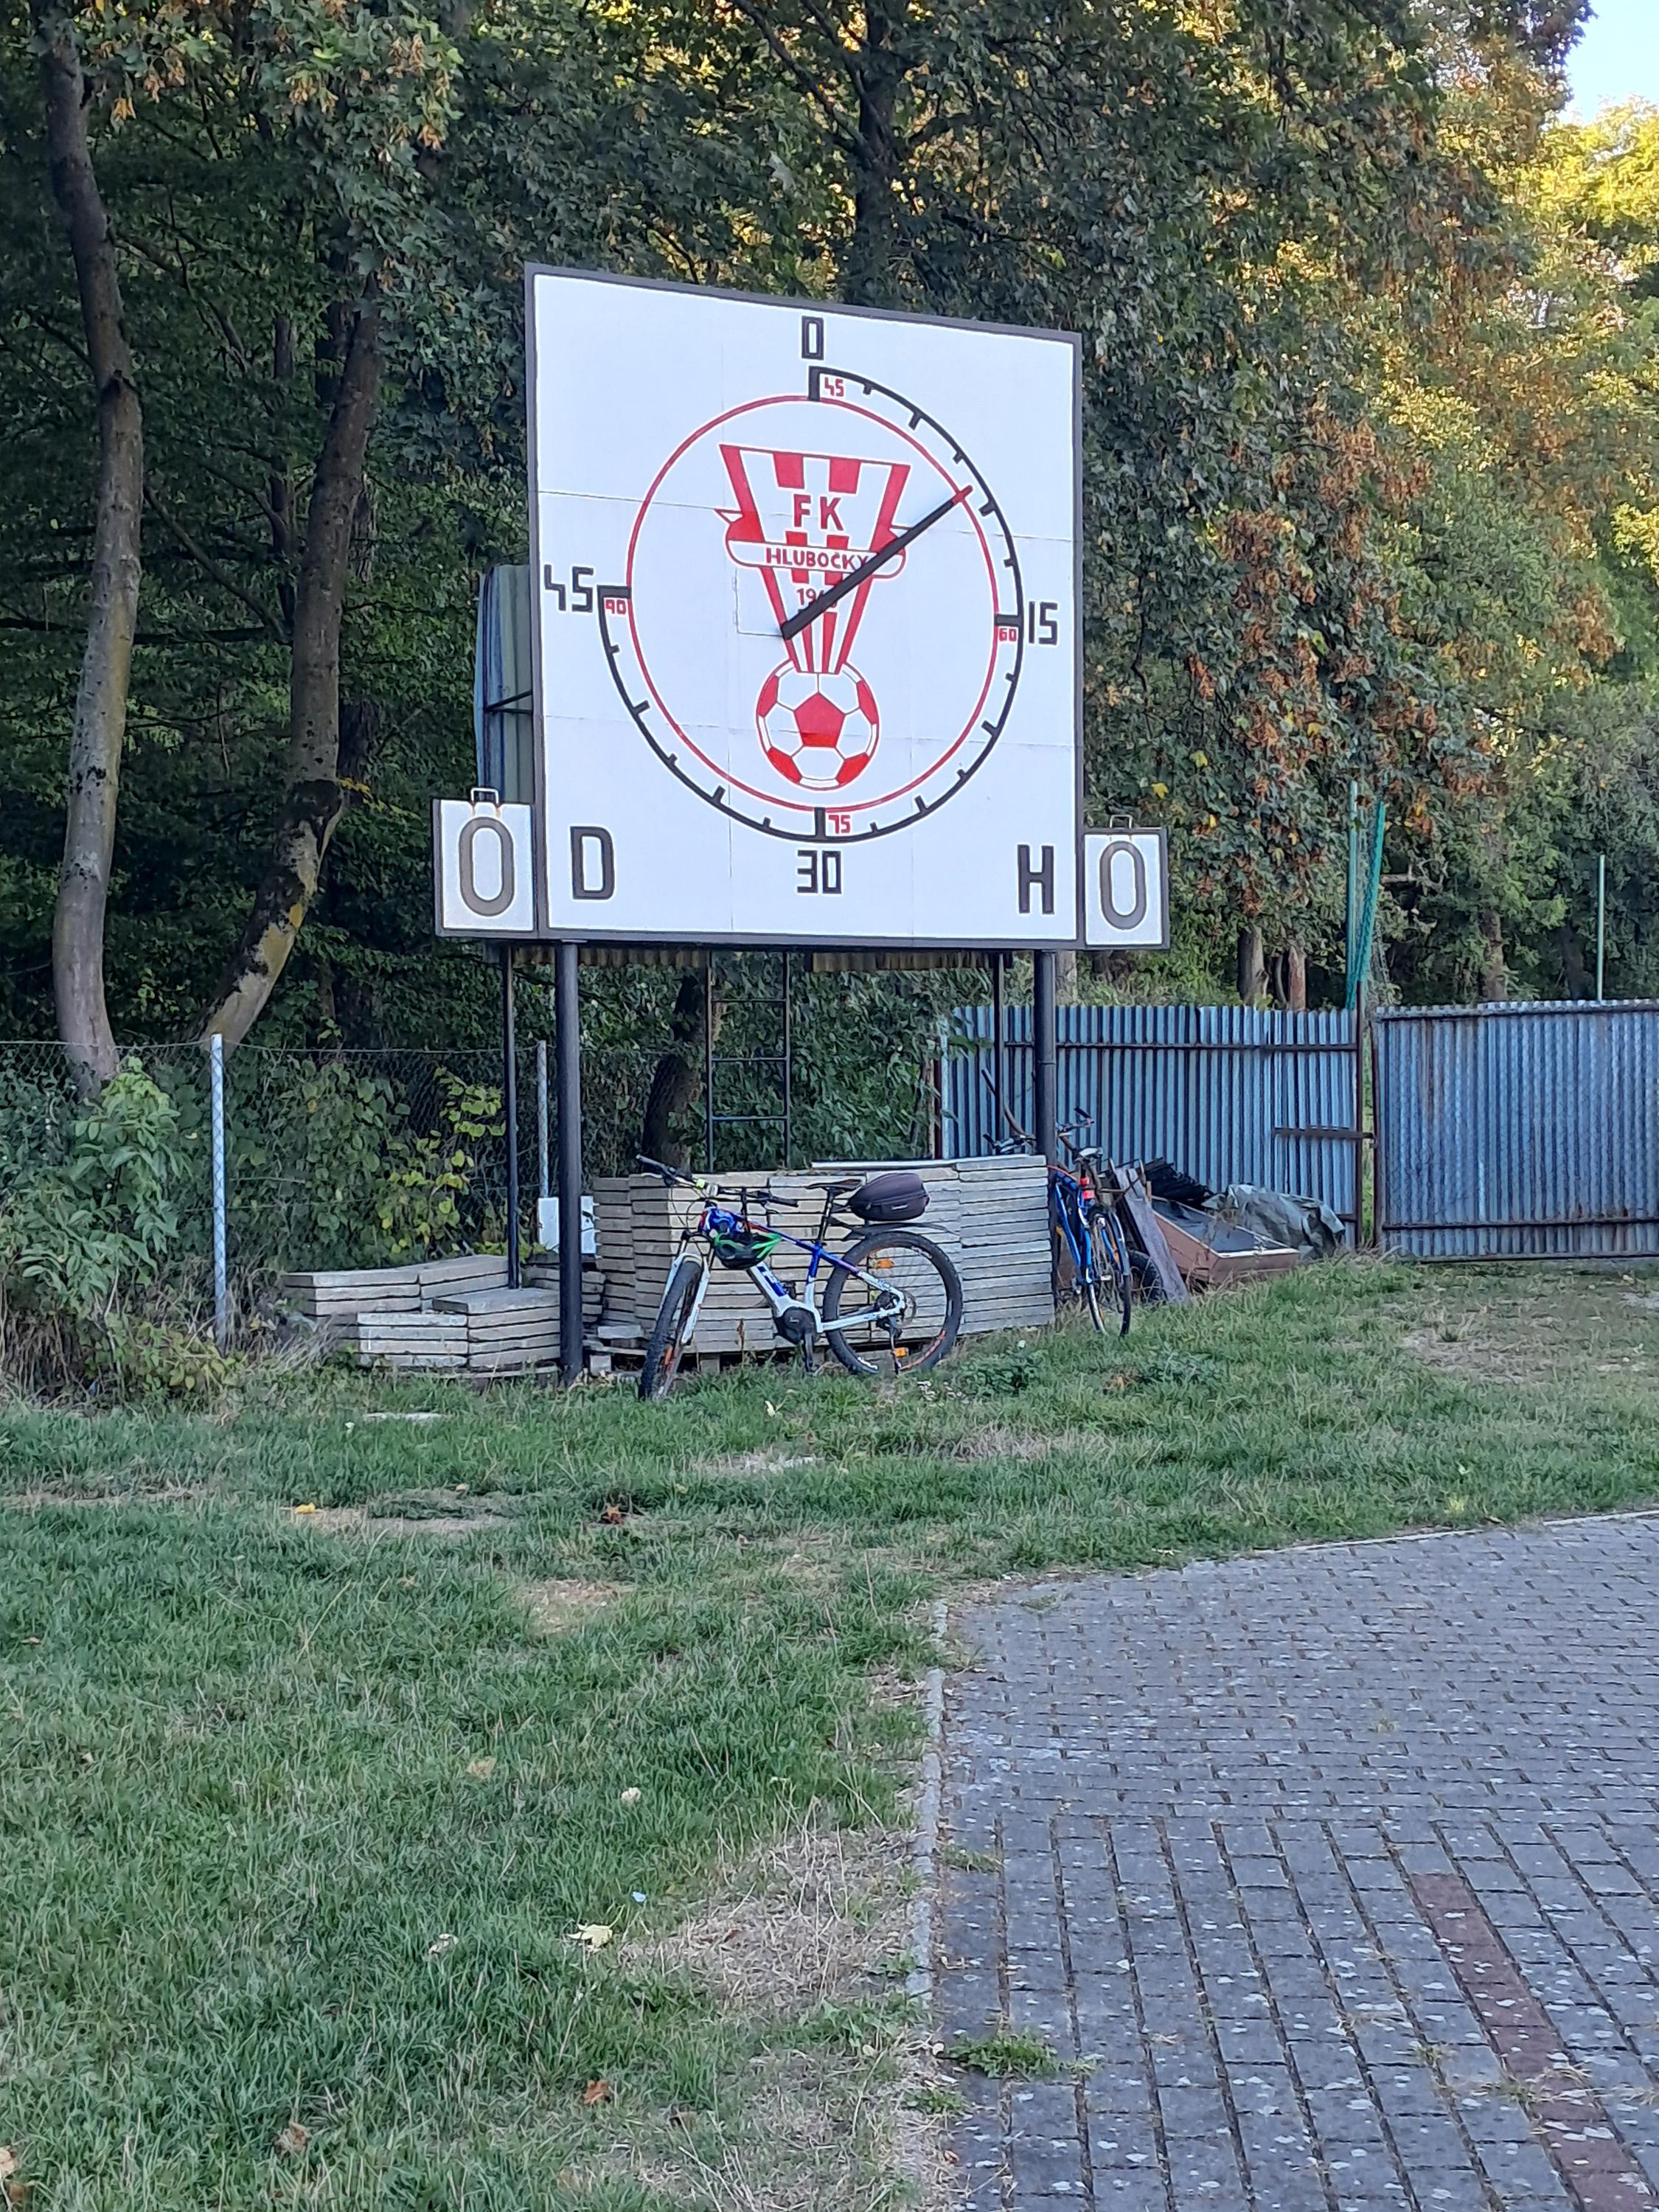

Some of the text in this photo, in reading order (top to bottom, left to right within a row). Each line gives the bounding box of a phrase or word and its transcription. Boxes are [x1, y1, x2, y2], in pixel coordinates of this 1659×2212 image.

[801, 316, 824, 361] 0
[824, 377, 844, 397] 45
[793, 493, 844, 531] FK
[544, 564, 594, 613] 45
[605, 599, 626, 614] 90
[998, 627, 1017, 641] 60
[1028, 601, 1058, 646] 15
[828, 814, 851, 834] 75
[459, 816, 515, 917] 0
[570, 825, 616, 901] D
[797, 849, 842, 894] 30
[1017, 844, 1055, 915] H
[1099, 840, 1147, 930] 0
